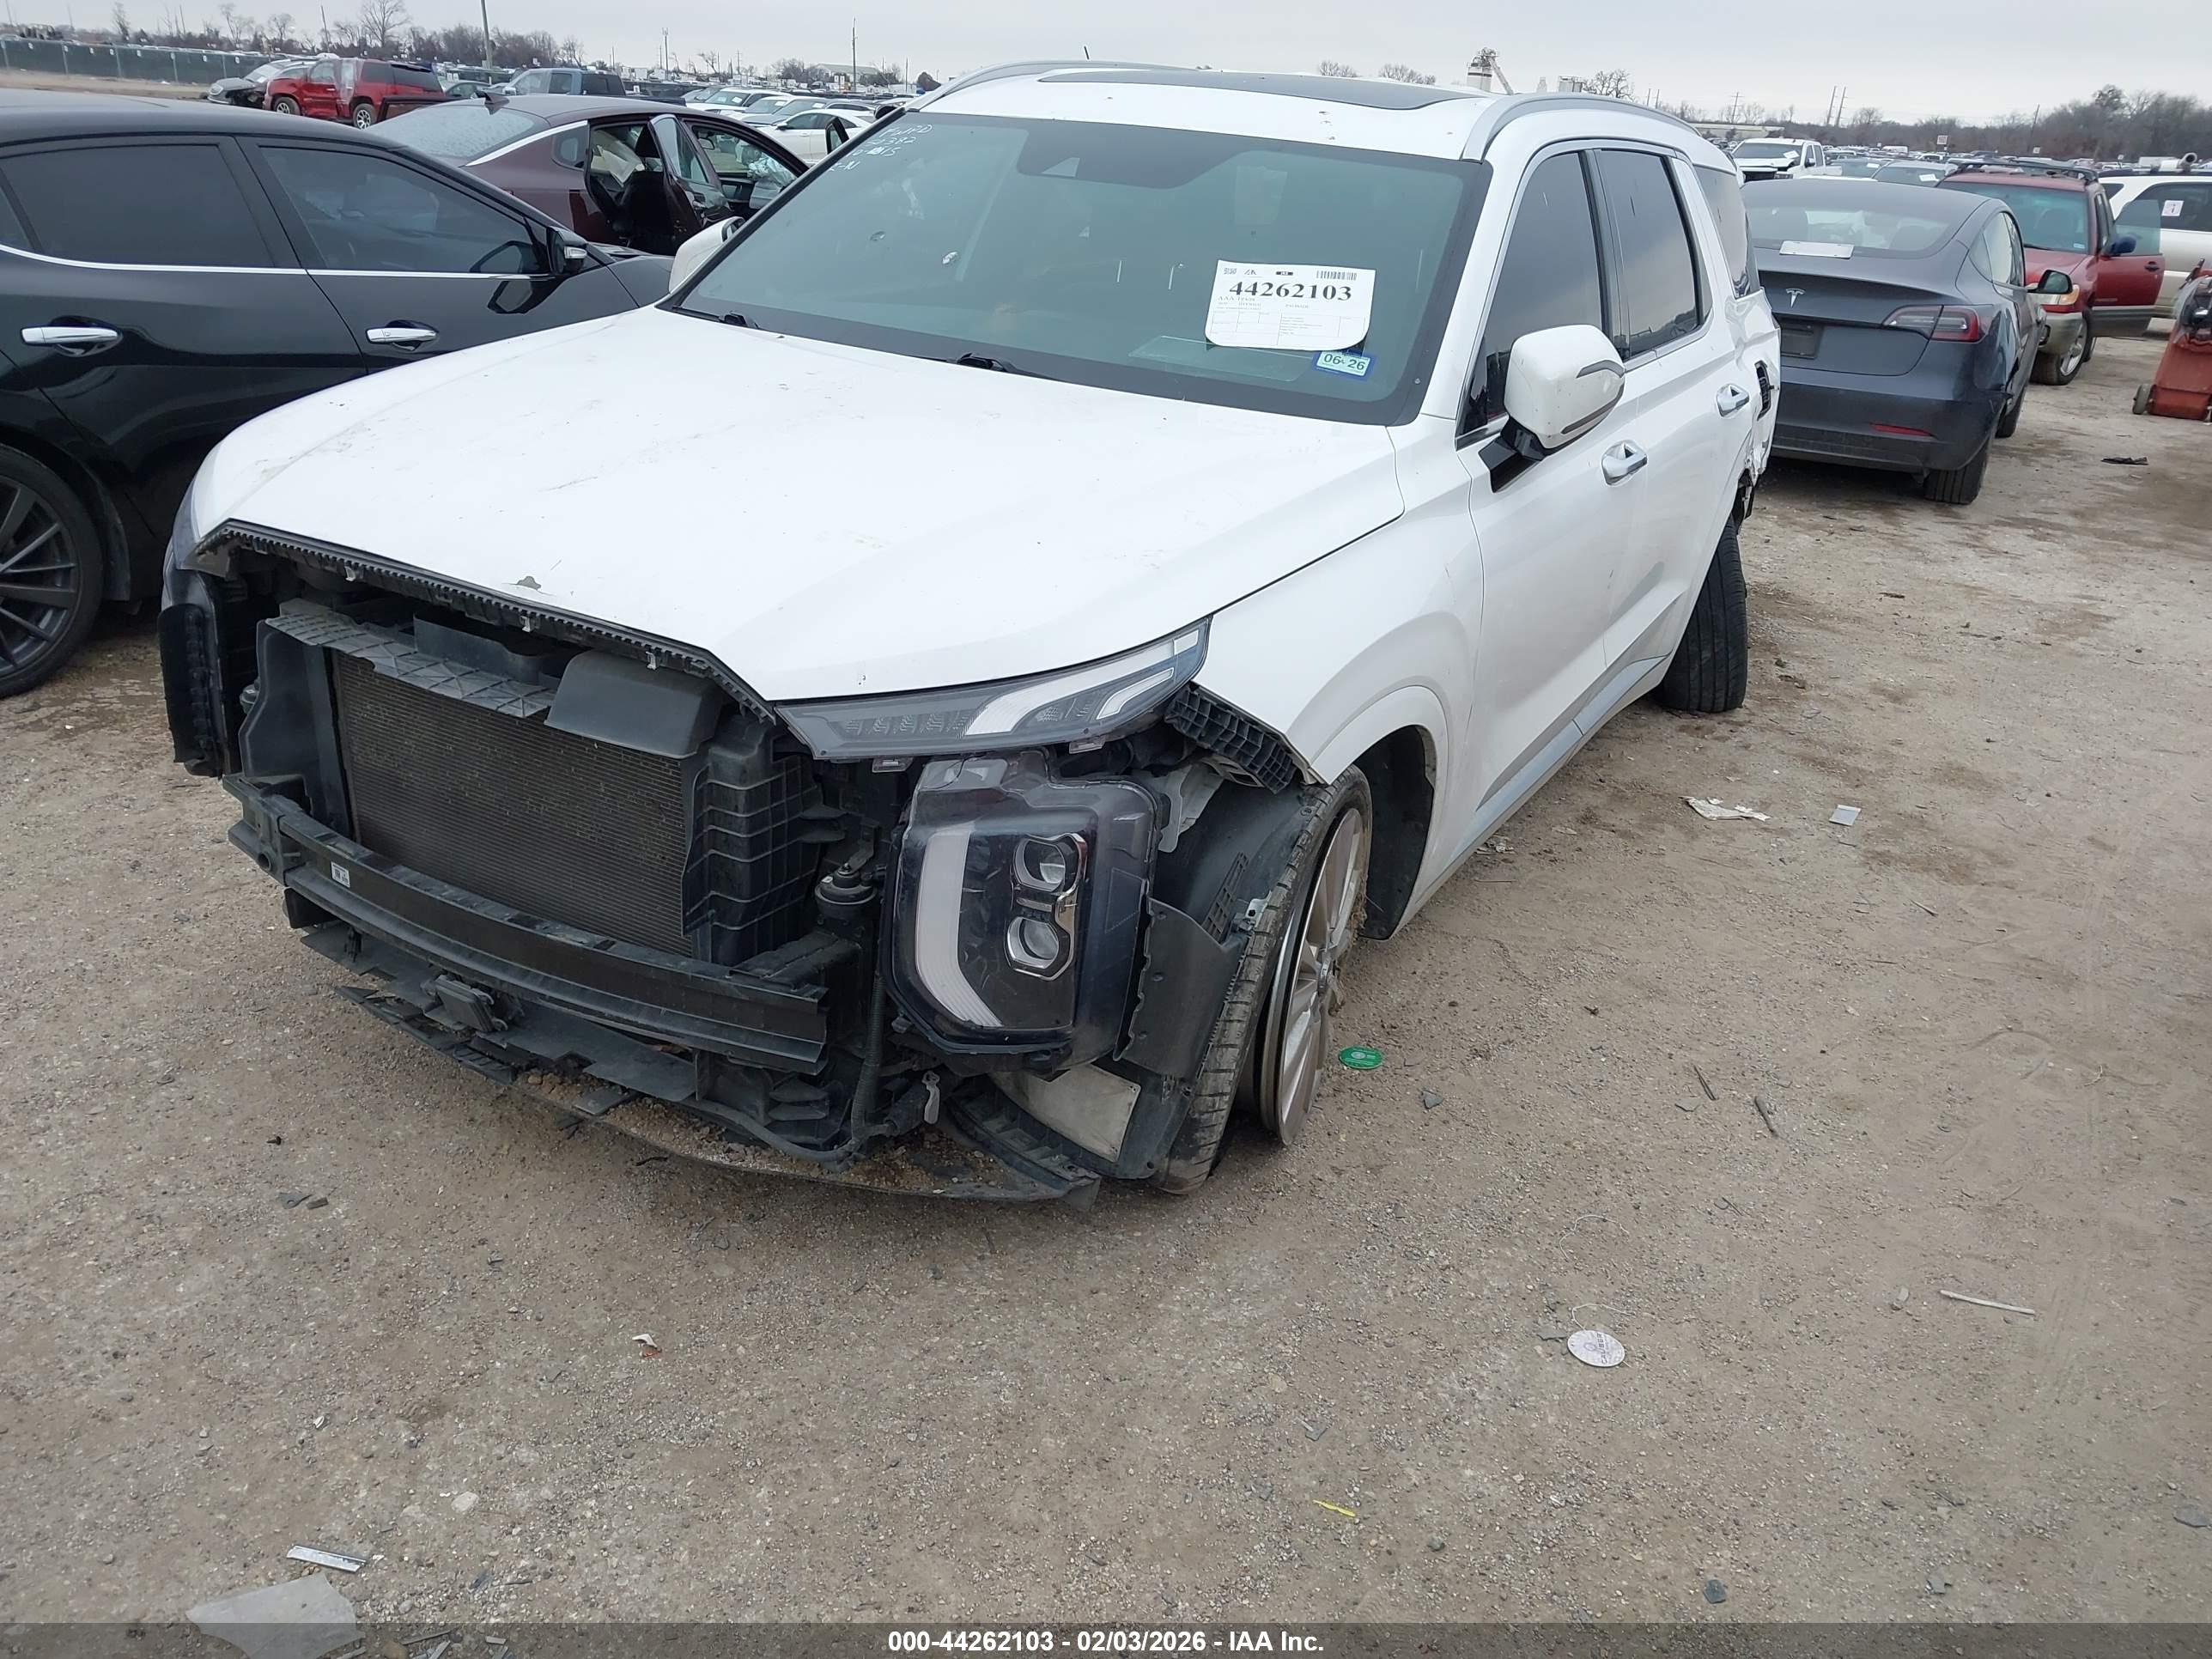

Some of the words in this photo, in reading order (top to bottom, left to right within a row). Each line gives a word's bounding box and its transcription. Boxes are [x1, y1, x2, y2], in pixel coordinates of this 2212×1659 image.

[1229, 280, 1352, 301] 44262103
[1323, 353, 1341, 365] 06
[1347, 358, 1366, 371] 26
